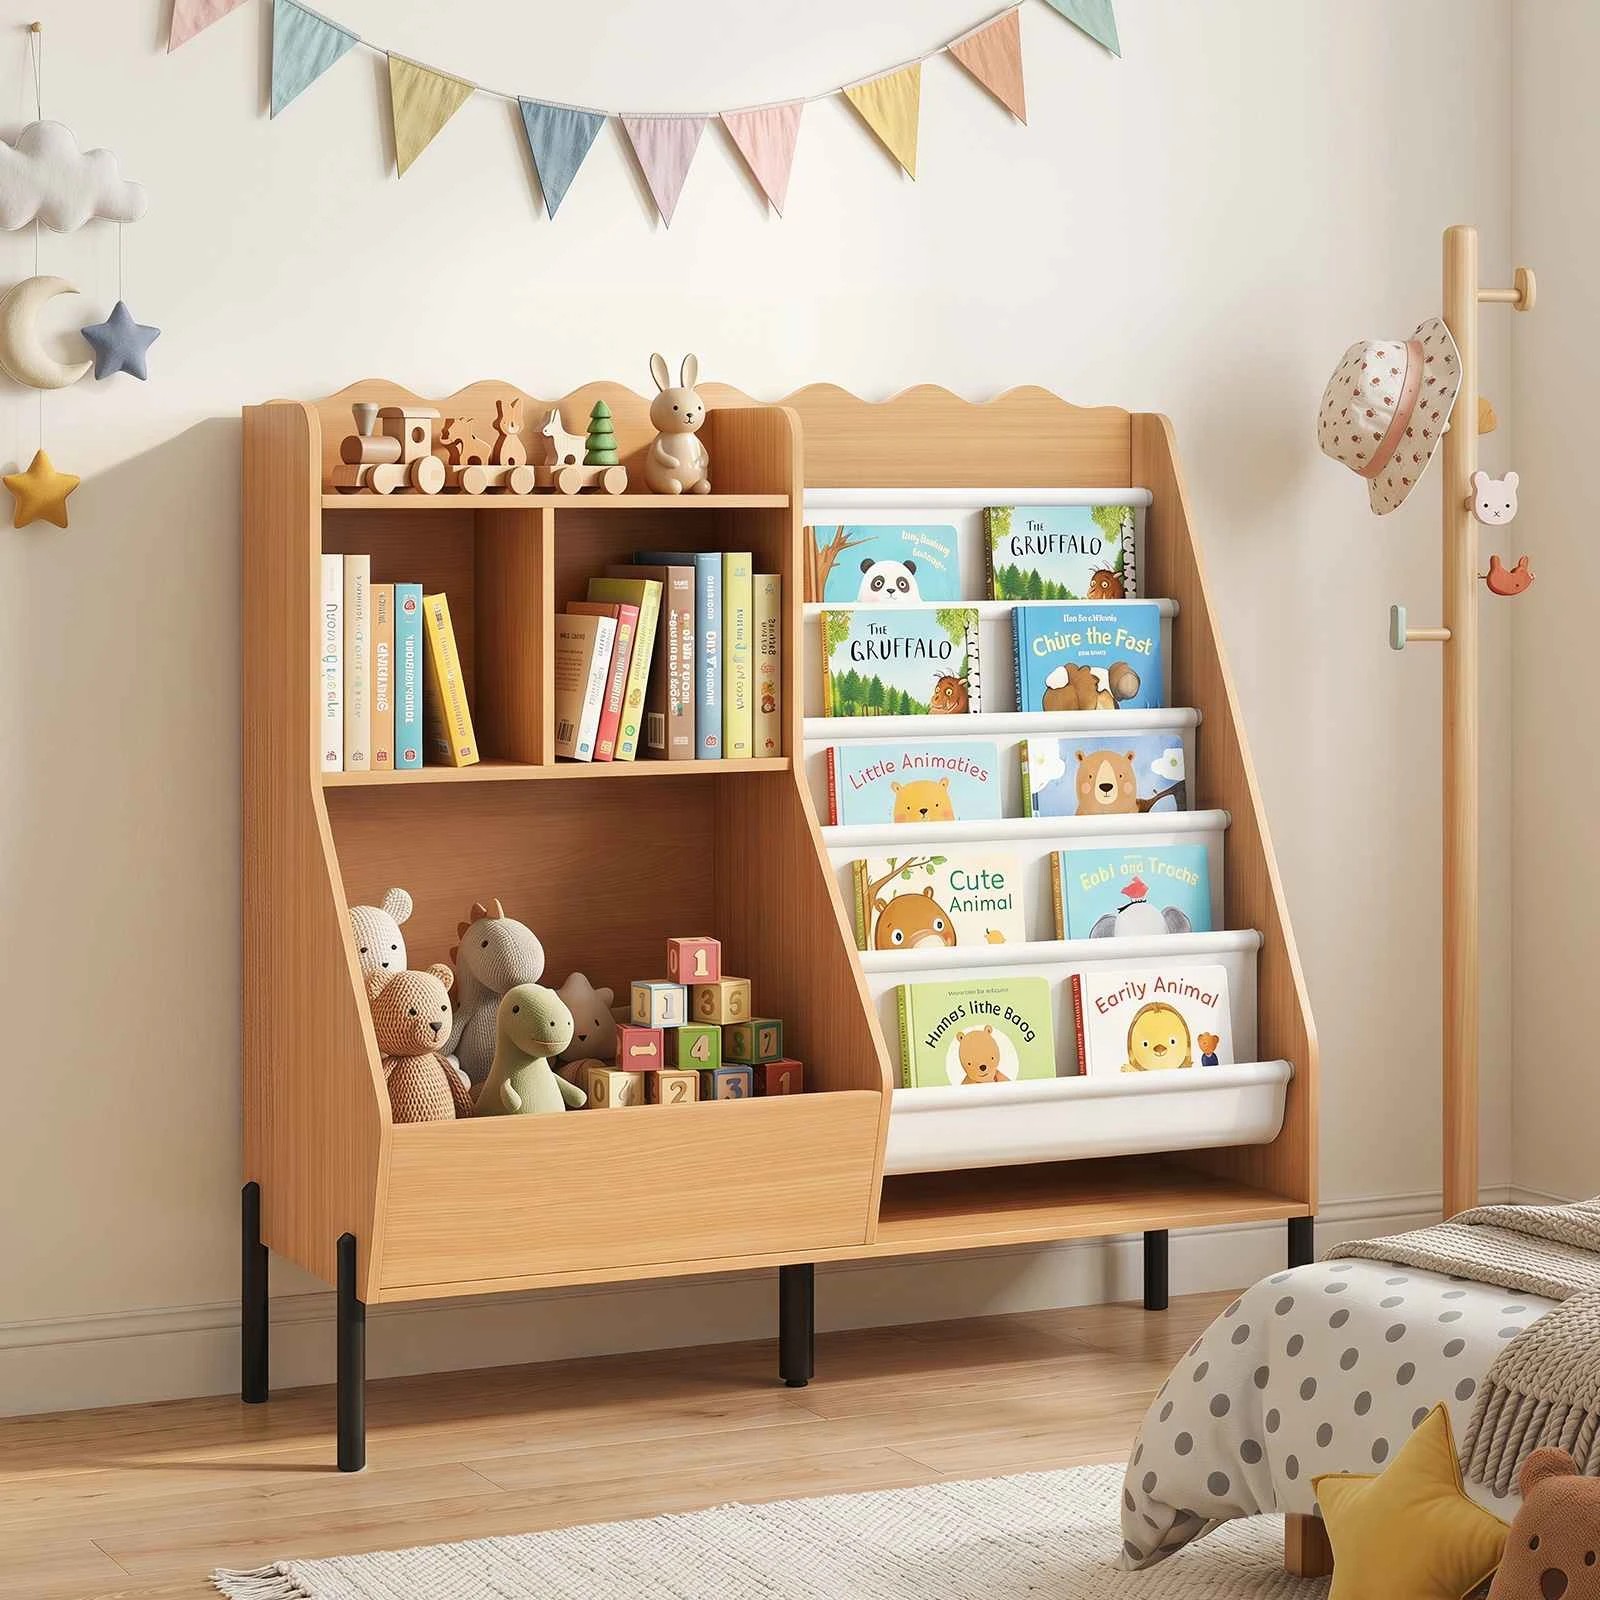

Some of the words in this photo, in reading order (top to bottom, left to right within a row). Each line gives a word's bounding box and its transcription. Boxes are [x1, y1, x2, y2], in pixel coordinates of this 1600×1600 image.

[1010, 534, 1102, 556] GRUFFALO
[850, 637, 952, 661] GRUFFALO
[1086, 626, 1112, 645] the
[1115, 628, 1153, 656] Fast
[848, 760, 896, 790] Little
[902, 752, 989, 784] Animaties
[950, 869, 1005, 891] Cute
[949, 893, 1012, 913] Animal
[693, 948, 709, 976] 1
[1094, 981, 1147, 1014] Earily
[1153, 976, 1220, 1009] Animal
[690, 1034, 711, 1062] 4
[670, 1080, 688, 1104] 2
